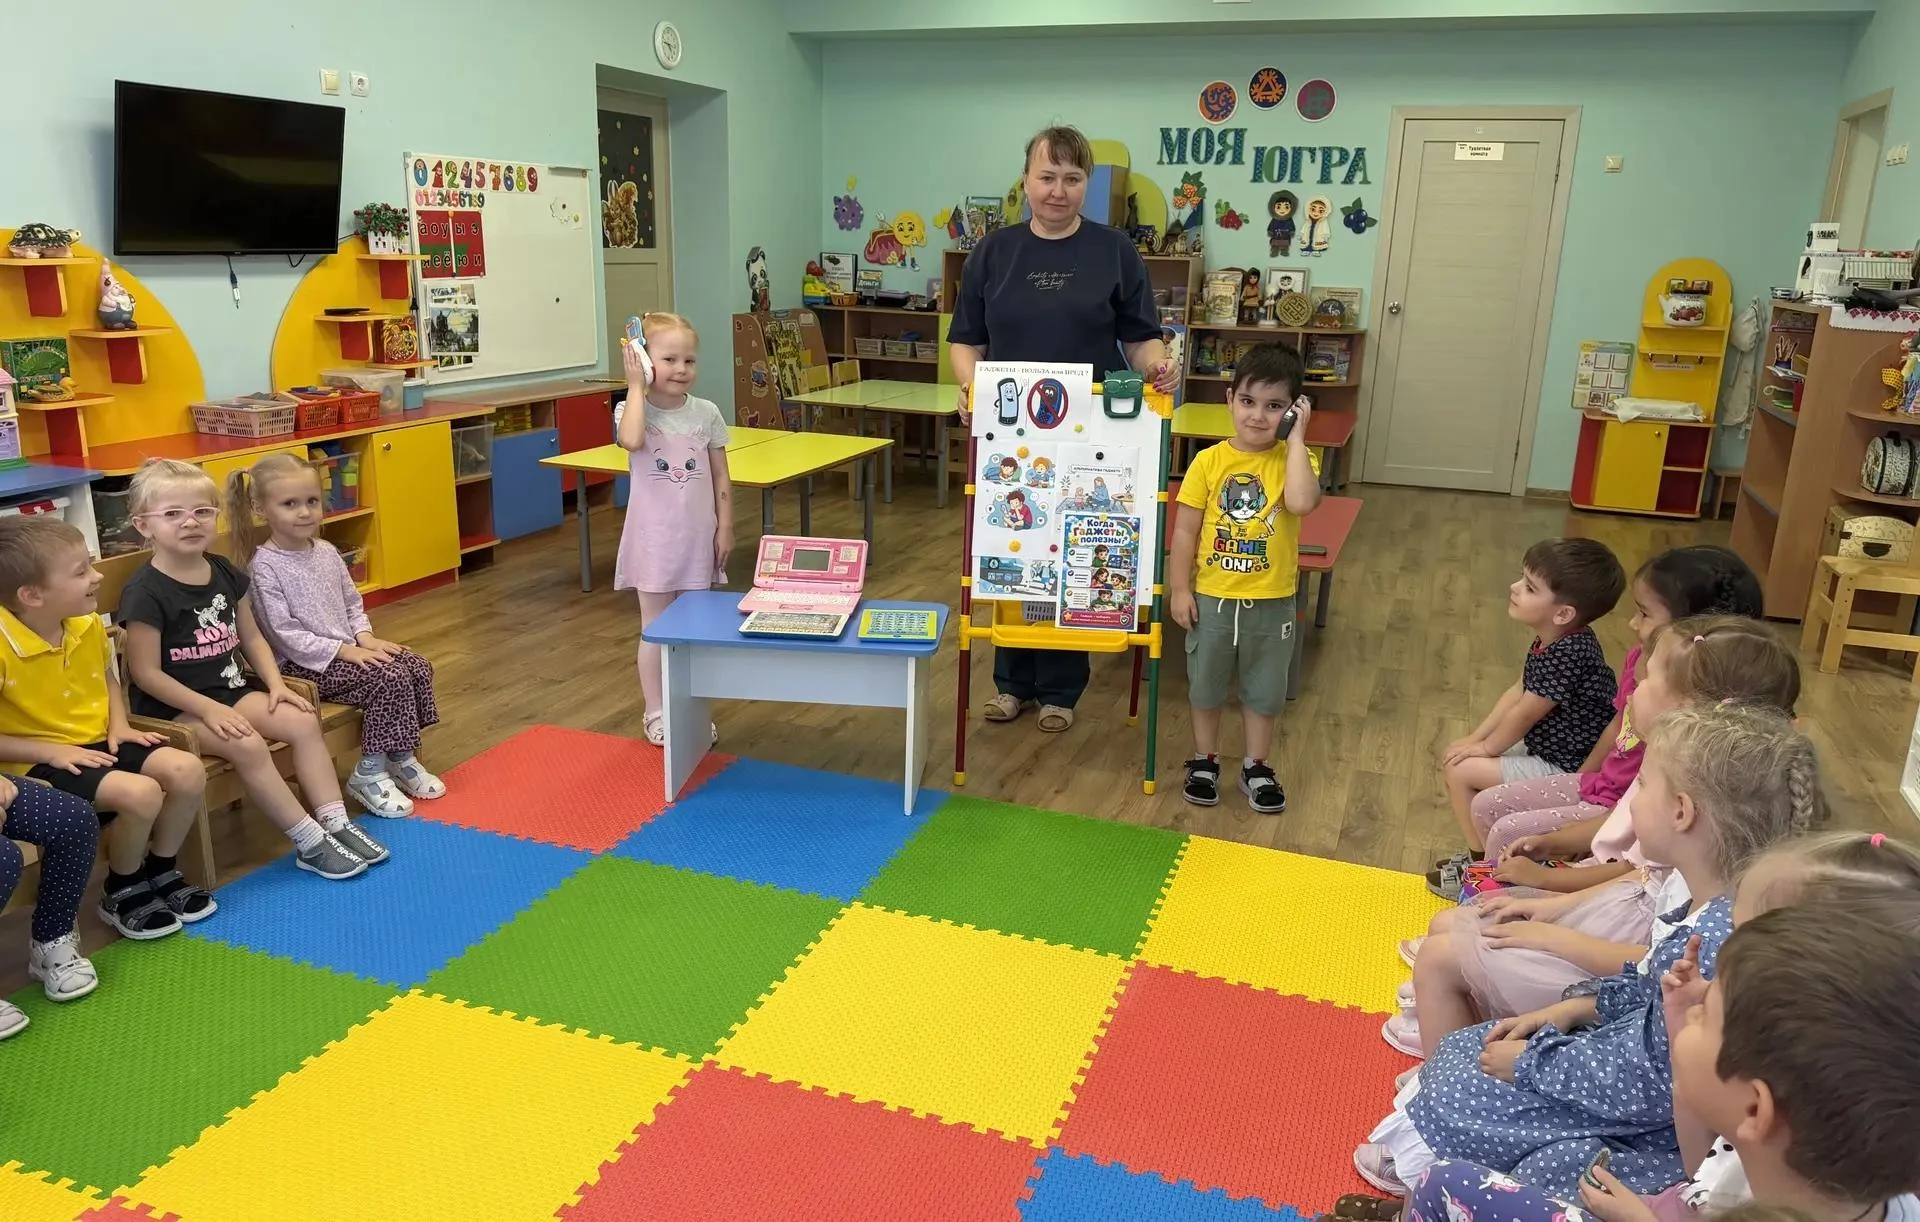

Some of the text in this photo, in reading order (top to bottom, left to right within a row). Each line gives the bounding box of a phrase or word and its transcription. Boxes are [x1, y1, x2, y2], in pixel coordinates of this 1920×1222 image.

[1156, 127, 1248, 165] МОЯ
[1250, 146, 1372, 184] ЮГРА
[1087, 519, 1114, 528] Когда
[1214, 537, 1267, 555] GAME
[1221, 556, 1253, 573] ON!
[193, 622, 229, 645] 101
